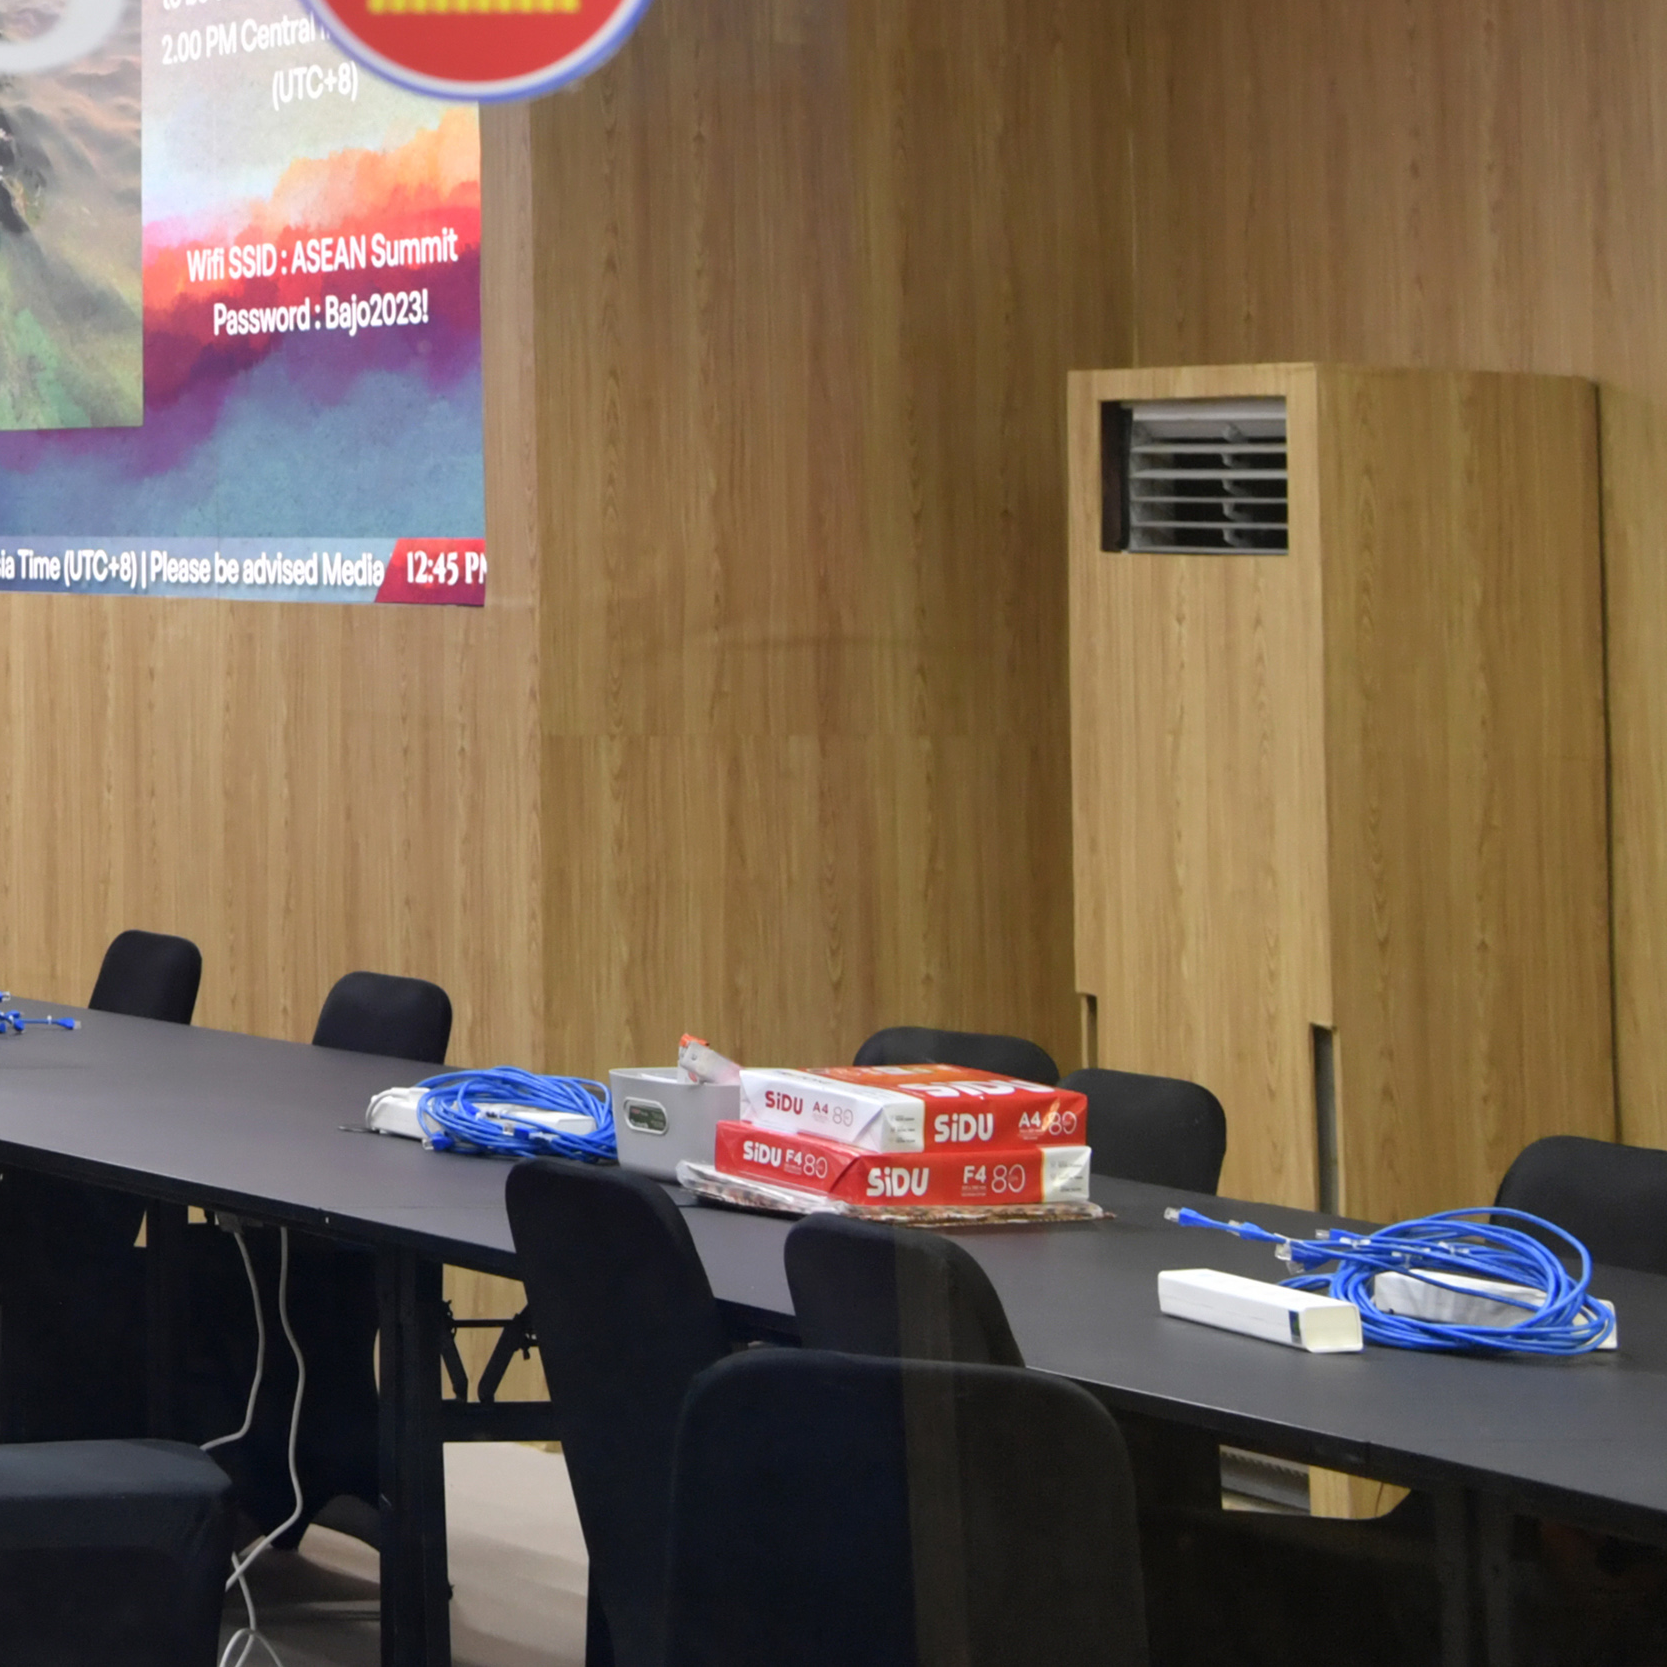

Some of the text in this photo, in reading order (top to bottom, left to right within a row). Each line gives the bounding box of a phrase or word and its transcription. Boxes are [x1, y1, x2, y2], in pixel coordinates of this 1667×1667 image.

[161, 29, 202, 65] 2.00
[205, 22, 237, 58] PM
[240, 11, 316, 53] Central
[272, 61, 358, 111] (UTC+8)
[187, 248, 225, 282] Wifi
[228, 243, 278, 279] SSID
[291, 234, 367, 275] ASEAN
[370, 227, 459, 268] Summit
[213, 296, 311, 336] Password
[325, 289, 429, 337] Bajo2023!
[17, 548, 61, 581] Time
[63, 549, 137, 589] (UTC+8)
[150, 550, 211, 583] Please
[214, 551, 240, 585] be
[242, 551, 318, 586] advised
[322, 552, 385, 587] Media
[406, 550, 459, 585] 12:45
[812, 1101, 829, 1114] A4
[832, 1106, 854, 1127] 80
[1018, 1110, 1042, 1128] A4
[1048, 1110, 1078, 1136] 80
[785, 1148, 803, 1166] F4
[803, 1153, 828, 1179] 80
[963, 1164, 987, 1184] F4
[991, 1163, 1026, 1194] 80
